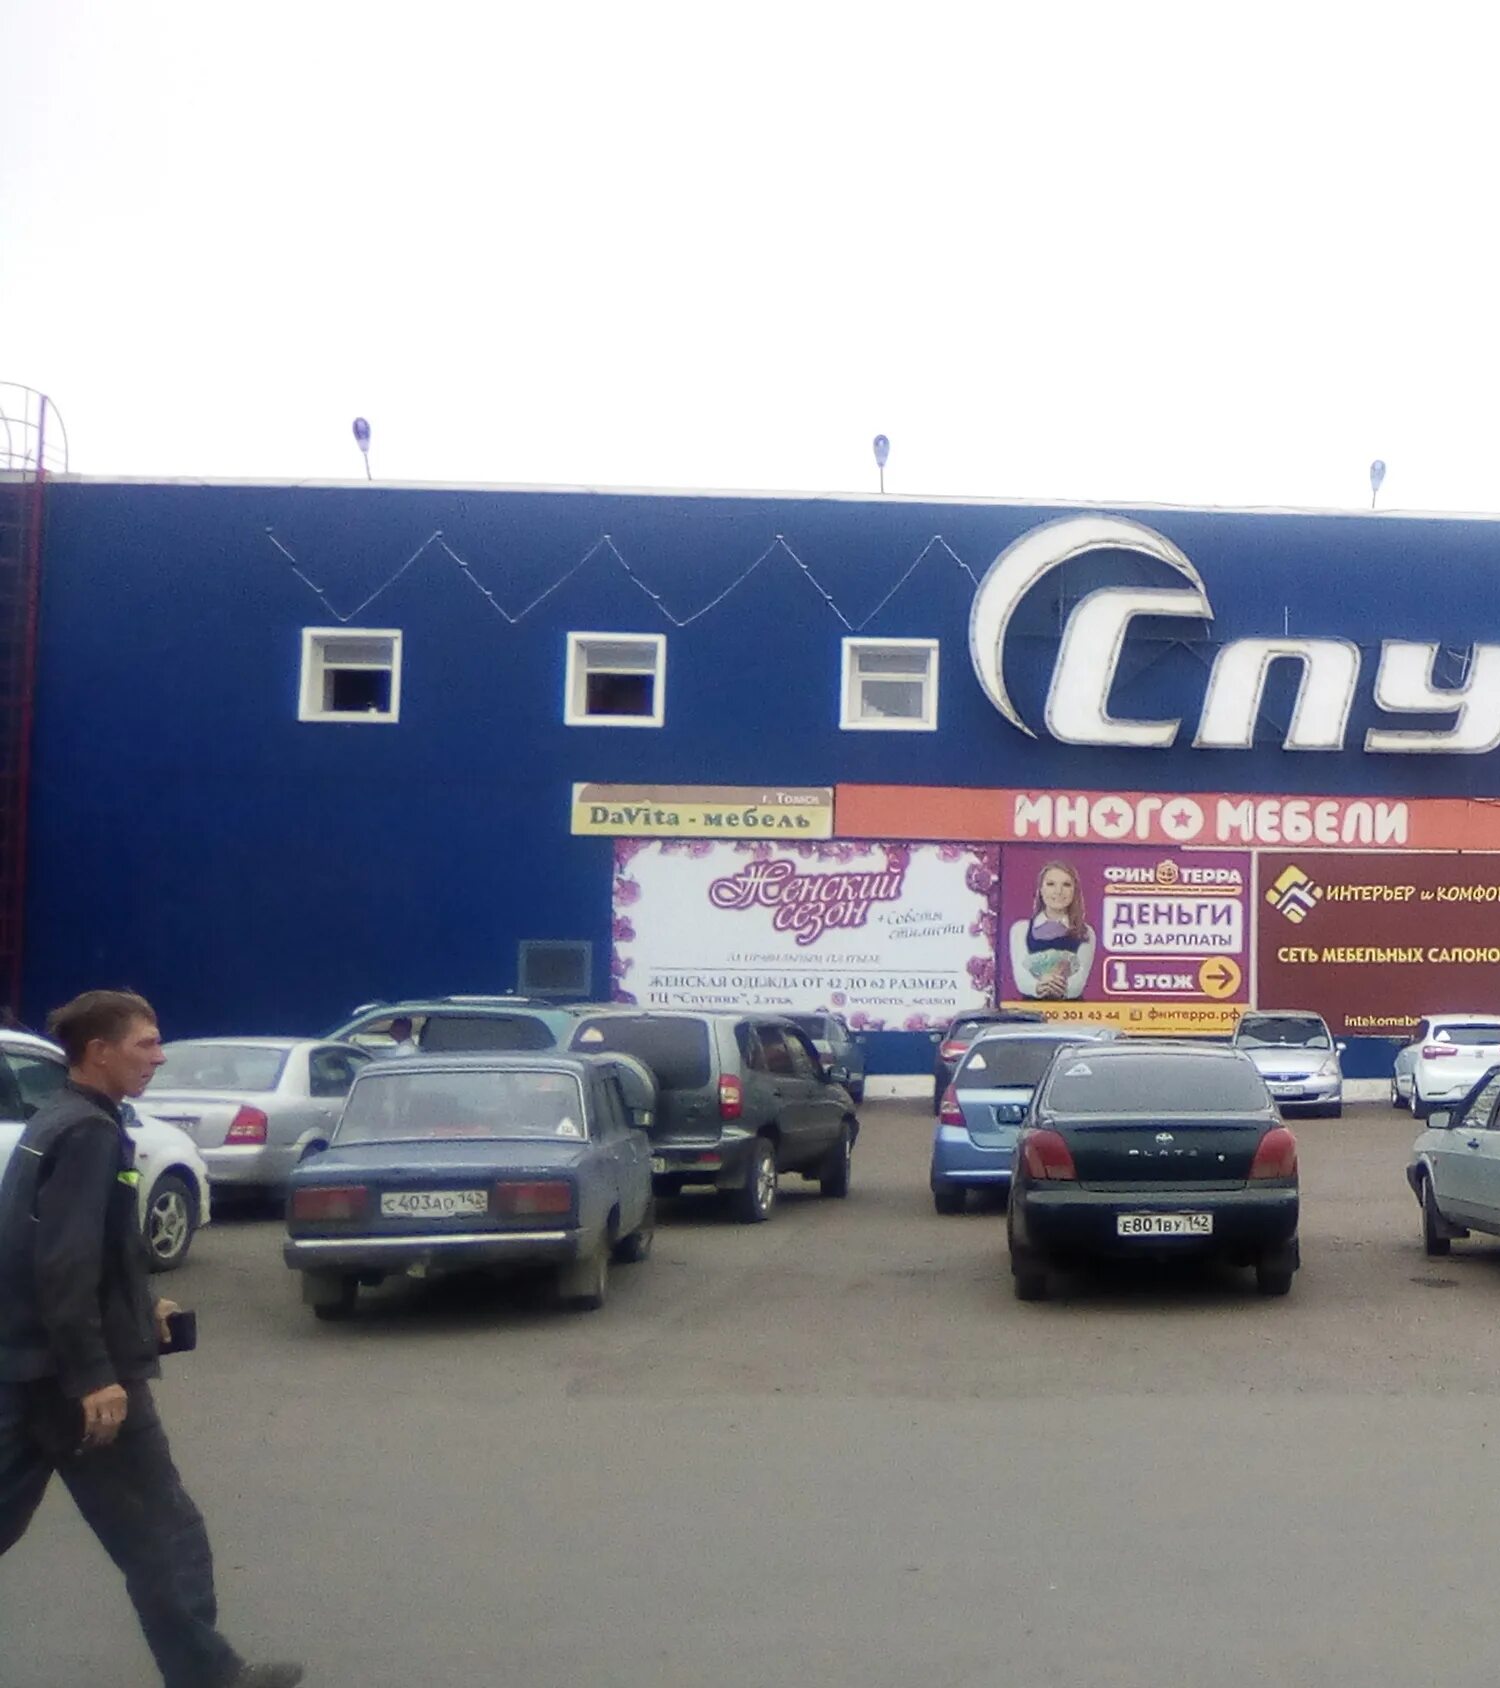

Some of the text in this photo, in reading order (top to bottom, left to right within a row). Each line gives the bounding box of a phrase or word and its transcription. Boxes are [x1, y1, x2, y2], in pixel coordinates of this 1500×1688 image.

[589, 804, 681, 827] DaVita
[702, 804, 811, 829] мебель
[1014, 794, 1409, 845] МНОГО МЕБЕЛИ
[709, 860, 905, 909] Женский
[1326, 884, 1416, 903] ИНТЕРЬЕР
[774, 900, 872, 945] сезон
[1111, 902, 1233, 929] ДЕНЬГИ
[1112, 933, 1232, 947] ДО ЗАРПЛАТЫ
[1277, 947, 1319, 963] СЕТЬ
[1321, 947, 1424, 963] МЕБЕЛЬНЫХ
[648, 975, 727, 989] ЖЕНСКАЯ
[731, 976, 799, 990] ОДЕЖДА
[802, 976, 825, 989] ОТ
[844, 977, 868, 991] ДО
[889, 978, 958, 990] РАЗМЕРА
[1111, 961, 1195, 990] 1 этаж
[1062, 1010, 1084, 1020] 301
